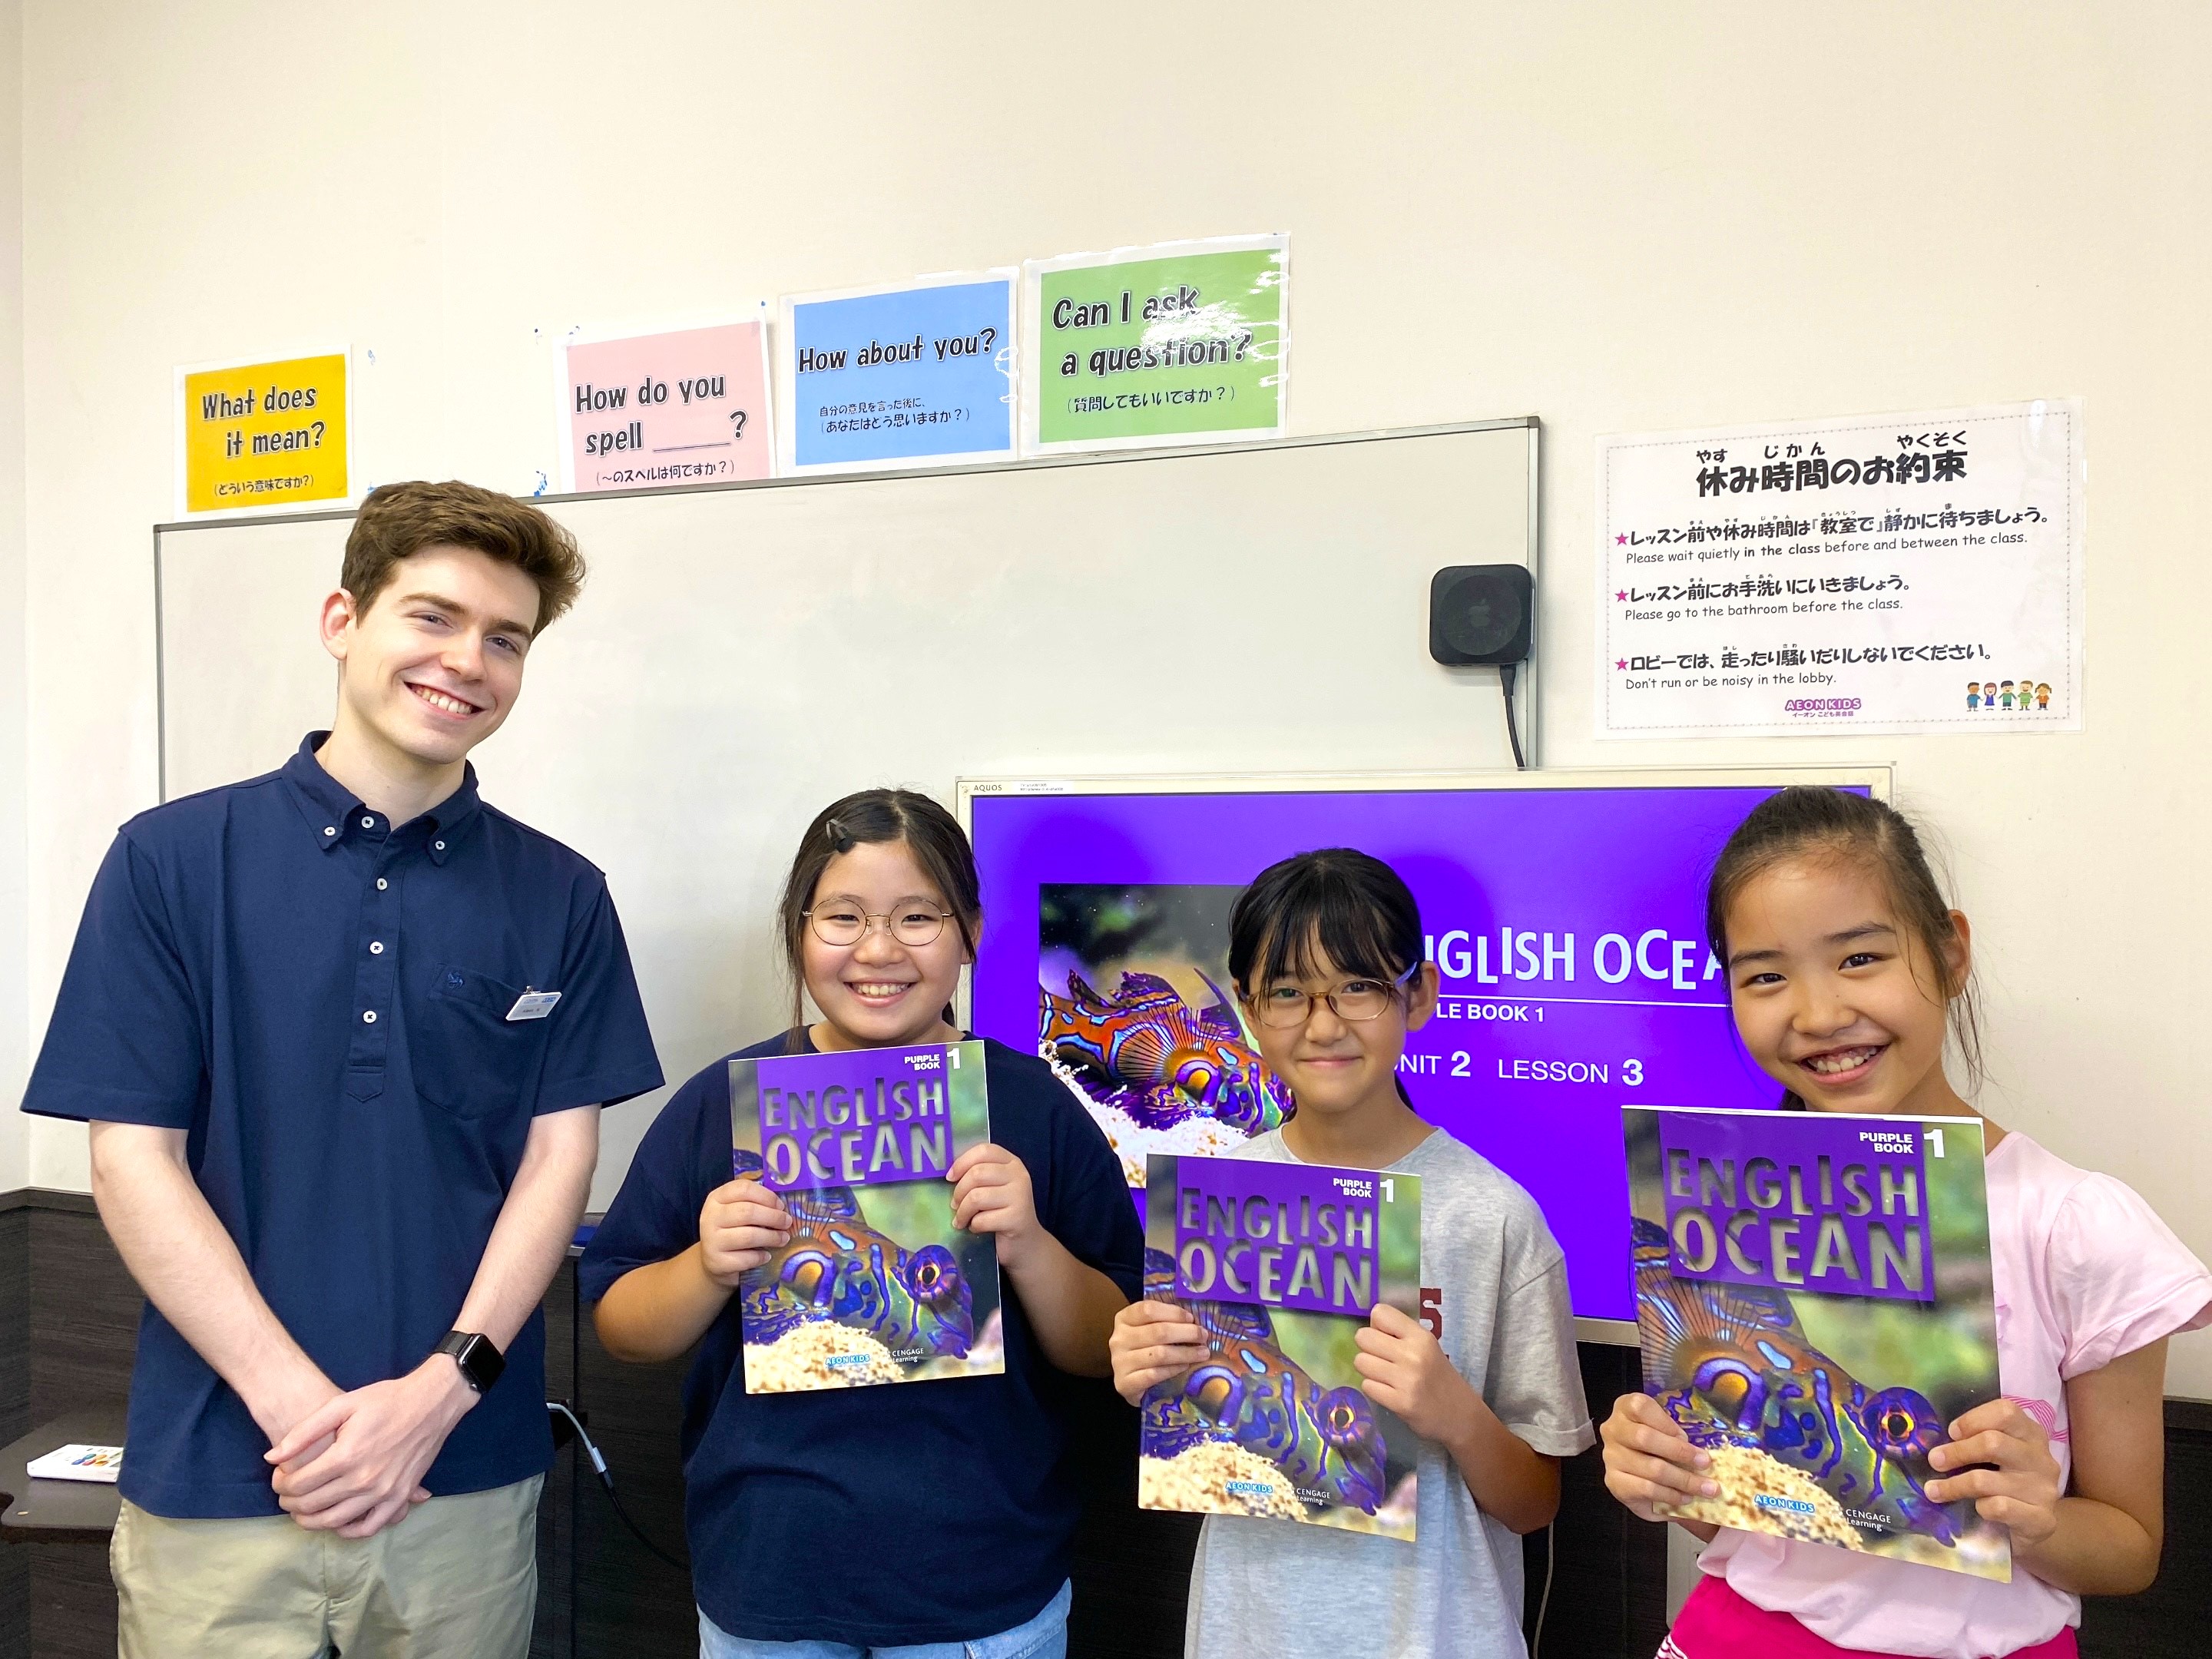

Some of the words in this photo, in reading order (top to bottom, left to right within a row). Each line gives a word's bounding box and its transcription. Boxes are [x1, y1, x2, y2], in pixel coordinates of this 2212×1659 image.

[1052, 297, 1109, 329] Can
[1121, 290, 1131, 323] I
[1141, 285, 1199, 320] ask
[798, 346, 848, 373] How
[857, 334, 924, 366] about
[933, 326, 996, 362] you?
[1061, 353, 1078, 376] a
[1088, 328, 1252, 377] question?
[202, 388, 255, 421] What
[264, 385, 316, 413] does
[575, 383, 627, 413] How
[637, 376, 668, 406] do
[678, 375, 726, 405] you
[226, 430, 243, 459] it
[252, 421, 326, 455] mean?
[585, 421, 642, 456] spell
[1697, 449, 1727, 463] やす
[1765, 442, 1825, 459] じかん
[1897, 430, 1967, 449] やくそく
[1696, 450, 1968, 497] 休み時間のお約束
[1627, 553, 1664, 564] Please
[1668, 550, 1694, 561] wait
[1697, 547, 1740, 562] quietly
[1744, 547, 1755, 557] in
[1761, 545, 1783, 556] the
[1788, 542, 1820, 555] class
[1825, 539, 1869, 553] before
[1874, 538, 1896, 550] and
[1901, 536, 1958, 549] between
[1962, 534, 1985, 545] the
[1991, 532, 2028, 544] class.
[1631, 575, 1909, 602] レッスン前にお手洗いにいきましょう。
[1625, 610, 1663, 621] Please
[1667, 611, 1681, 621] go
[1685, 608, 1698, 618] to
[1703, 606, 1724, 617] the
[1728, 604, 1788, 616] bathroom
[1793, 601, 1837, 613] before
[1841, 599, 1863, 611] the
[1868, 598, 1903, 610] class.
[1626, 677, 1657, 690] Don't
[1661, 678, 1681, 689] run
[1685, 678, 1698, 687] or
[1703, 677, 1718, 687] be
[1722, 674, 1753, 688] noisy
[1758, 674, 1769, 685] in
[1773, 673, 1795, 684] the
[1799, 672, 1836, 687] lobby.
[1785, 699, 1825, 711] AEON
[1827, 697, 1861, 710] KIDS
[1425, 926, 1575, 984] GLISH
[1468, 1004, 1529, 1022] BOOK
[1535, 1007, 1545, 1022] 1
[904, 1054, 940, 1065] PURPLE
[947, 1048, 961, 1069] 1
[914, 1061, 941, 1071] BOOK
[1394, 1053, 1442, 1075] NIT
[1451, 1050, 1471, 1078] 2
[1498, 1058, 1609, 1084] LESSON
[1622, 1058, 1644, 1086] 3
[763, 1078, 944, 1131] ENGLISH
[766, 1120, 947, 1186] OCEAN
[1859, 1131, 1912, 1144] PURPLE
[1923, 1129, 1945, 1158] 1
[1874, 1142, 1914, 1154] BOOK
[1333, 1177, 1373, 1190] PURPLE
[1380, 1178, 1394, 1203] 1
[1343, 1187, 1373, 1198] BOOK
[1667, 1148, 1920, 1217] ENGLISH
[1182, 1187, 1373, 1249] ENGLISH
[1673, 1206, 1923, 1291] OCEAN
[1180, 1237, 1371, 1310] OCEAN
[826, 1356, 849, 1365] AEON
[849, 1354, 870, 1363] KIDS
[892, 1347, 924, 1357] CENGAGE
[1225, 1481, 1250, 1492] AEON
[1251, 1483, 1273, 1494] KIDS
[1296, 1488, 1330, 1498] CENGAGE
[1297, 1495, 1323, 1505] Learning
[1754, 1494, 1786, 1510] AEON
[1786, 1500, 1815, 1513] KIDS
[1846, 1508, 1892, 1524] CENGAGE
[1846, 1518, 1882, 1532] Learning
